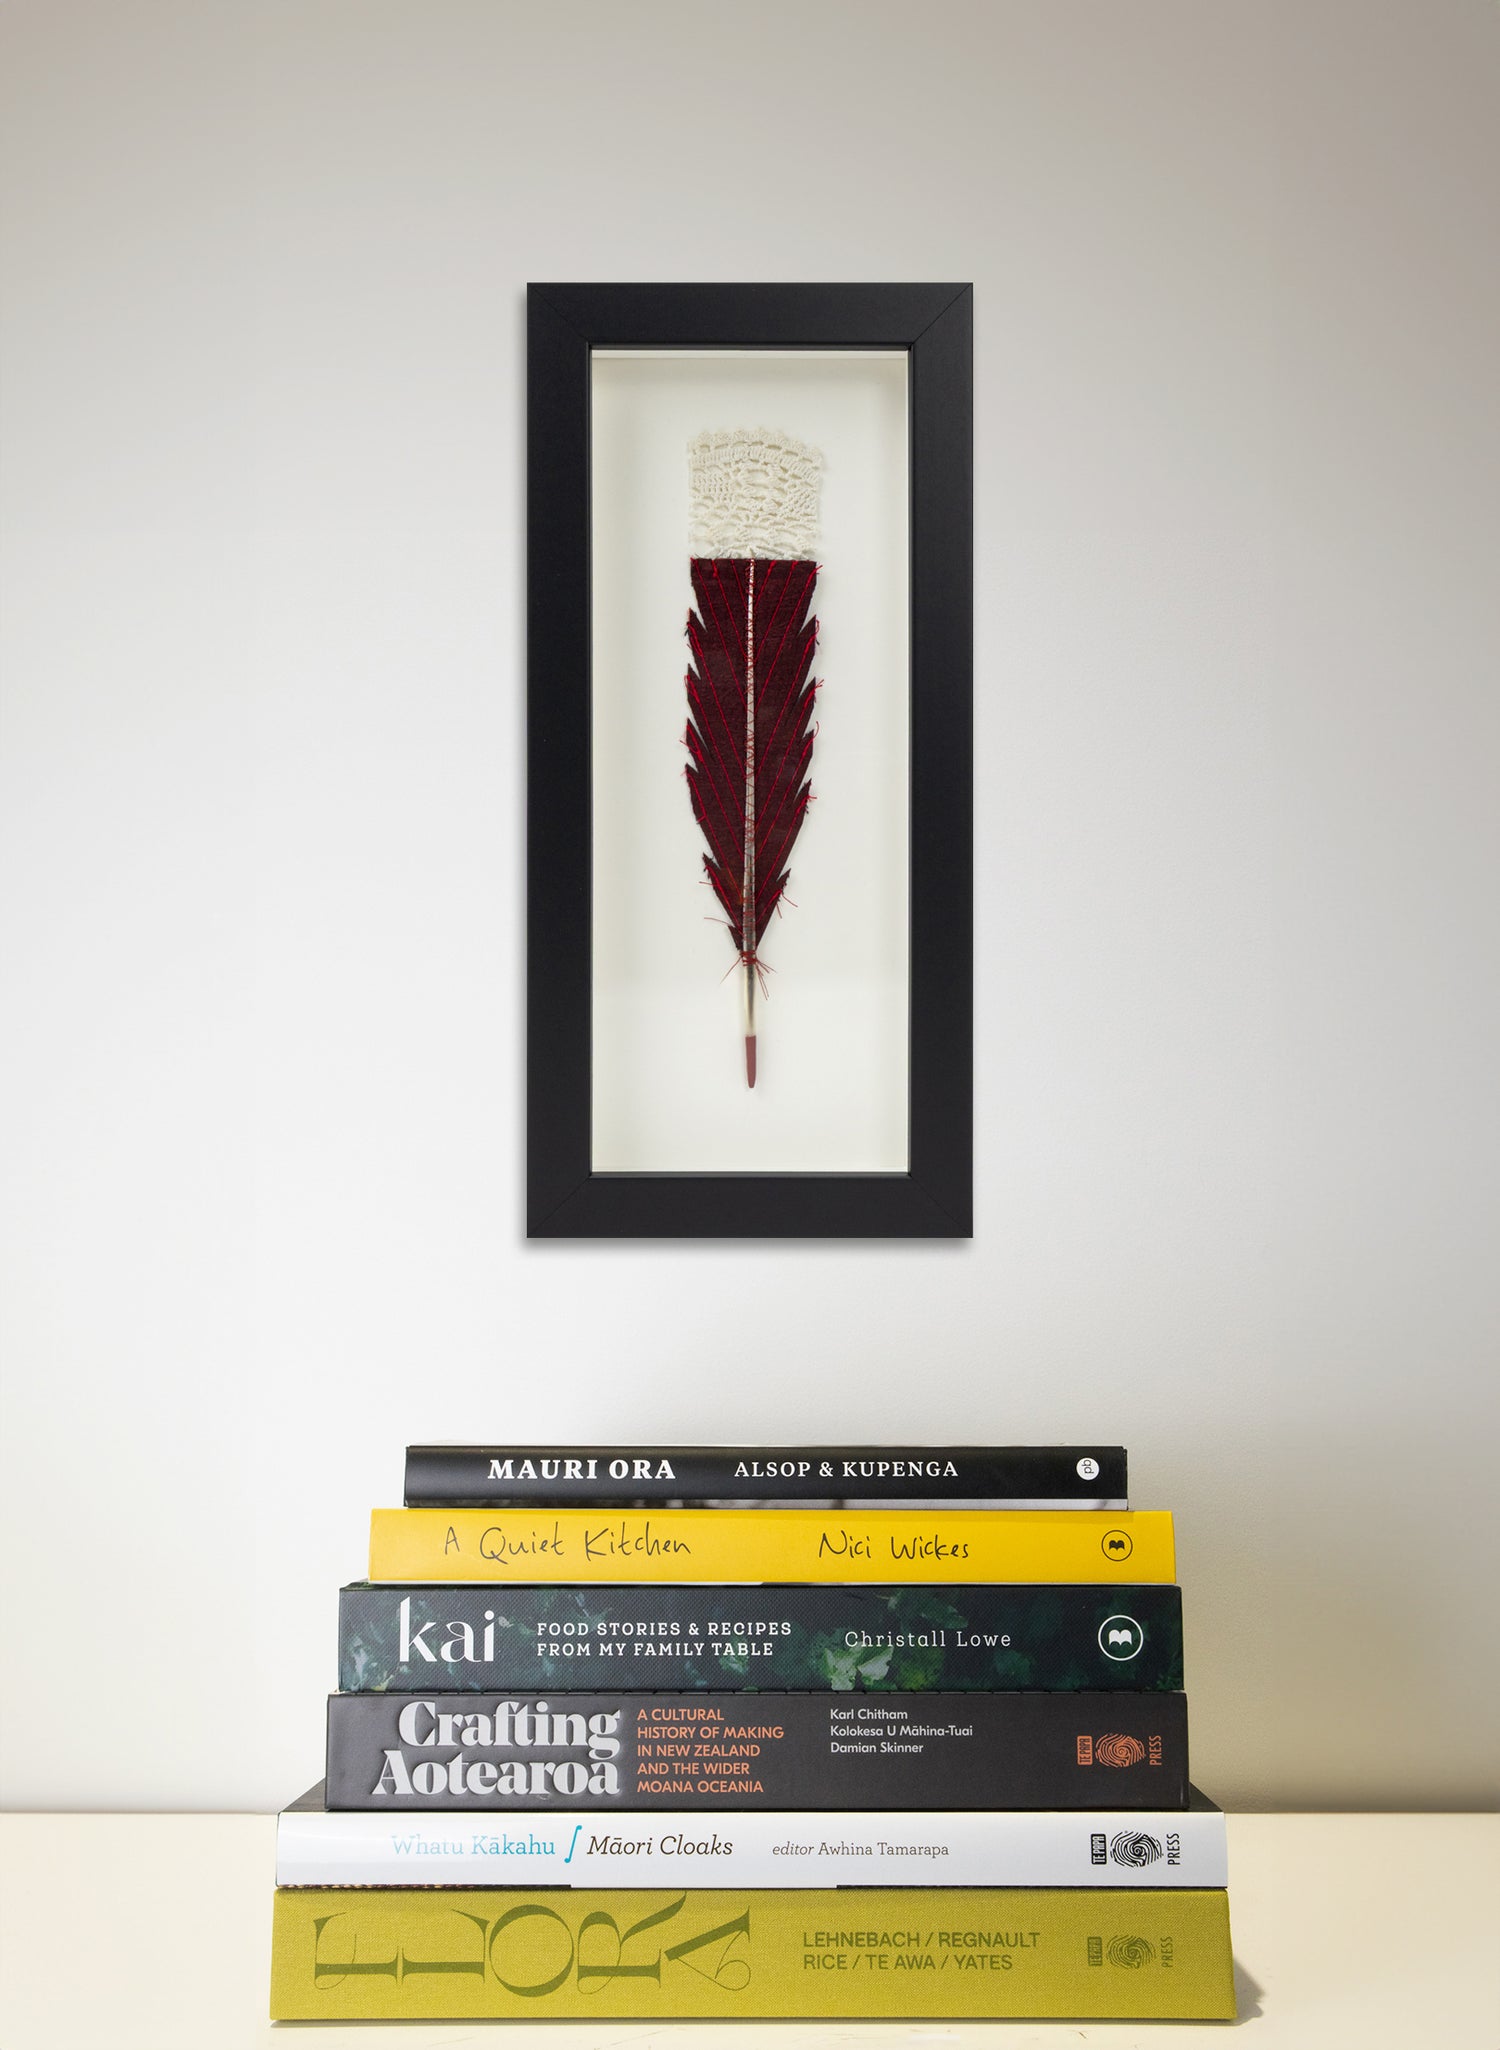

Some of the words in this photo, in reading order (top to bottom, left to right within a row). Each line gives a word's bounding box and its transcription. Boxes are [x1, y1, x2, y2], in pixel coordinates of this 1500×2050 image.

[487, 1460, 597, 1479] MAURI
[609, 1459, 676, 1479] ORA
[734, 1461, 810, 1478] ALSOP
[819, 1462, 833, 1477] &
[842, 1461, 959, 1477] KUPENGA
[444, 1526, 460, 1555] A
[479, 1521, 564, 1565] Quiet
[584, 1521, 691, 1561] Kitchen
[818, 1530, 871, 1559] Nici
[890, 1534, 969, 1560] Wickes
[400, 1596, 494, 1662] kai
[537, 1623, 590, 1636] FOOD
[597, 1622, 681, 1636] STORIES
[688, 1622, 699, 1636] &
[707, 1622, 791, 1636] RECIPES
[844, 1630, 946, 1647] Christall
[956, 1631, 1011, 1647] Lowe
[537, 1643, 591, 1656] FROM
[600, 1643, 625, 1656] MY
[633, 1643, 705, 1656] FAMILY
[711, 1643, 774, 1656] TABLE
[637, 1709, 648, 1721] A
[651, 1708, 724, 1721] CULTURAL
[831, 1708, 854, 1720] Karl
[858, 1708, 908, 1720] Chitham
[399, 1701, 621, 1759] Crafting
[637, 1726, 697, 1739] HISTORY
[700, 1726, 719, 1739] OF
[724, 1726, 784, 1739] MAKING
[831, 1725, 883, 1737] Kolokesa
[887, 1726, 897, 1737] U
[900, 1725, 973, 1737] Māhina-Tuai
[637, 1745, 652, 1757] IN
[656, 1745, 691, 1757] NEW
[694, 1745, 760, 1757] ZEALAND
[831, 1742, 877, 1753] Damian
[880, 1742, 923, 1753] Skinner
[1078, 1738, 1091, 1755] PAPA
[1149, 1735, 1162, 1766] PRESS
[1078, 1755, 1091, 1763] TE
[370, 1750, 621, 1796] Aotearoa
[637, 1762, 668, 1775] AND
[672, 1762, 700, 1775] THE
[703, 1762, 750, 1775] WIDER
[637, 1780, 694, 1793] MOANA
[697, 1780, 764, 1793] OCEANIA
[392, 1834, 463, 1855] Whatu
[472, 1834, 555, 1855] Kākahu
[587, 1835, 653, 1855] Māori
[660, 1835, 733, 1855] Cloaks
[772, 1842, 815, 1856] editor
[818, 1842, 873, 1856] Awhina
[877, 1842, 949, 1858] Tamarapa
[1093, 1836, 1106, 1854] PAPA
[1167, 1833, 1180, 1865] PRESS
[1093, 1855, 1106, 1864] TE
[803, 1931, 920, 1948] LEHNEBACH
[925, 1932, 933, 1948] /
[938, 1932, 1040, 1948] REGNAULT
[1160, 1936, 1173, 1968] PRESS
[804, 1955, 847, 1970] RICE
[852, 1955, 861, 1970] /
[865, 1955, 889, 1970] TE
[894, 1955, 936, 1970] AWA
[941, 1955, 949, 1970] /
[953, 1955, 1012, 1970] YATES
